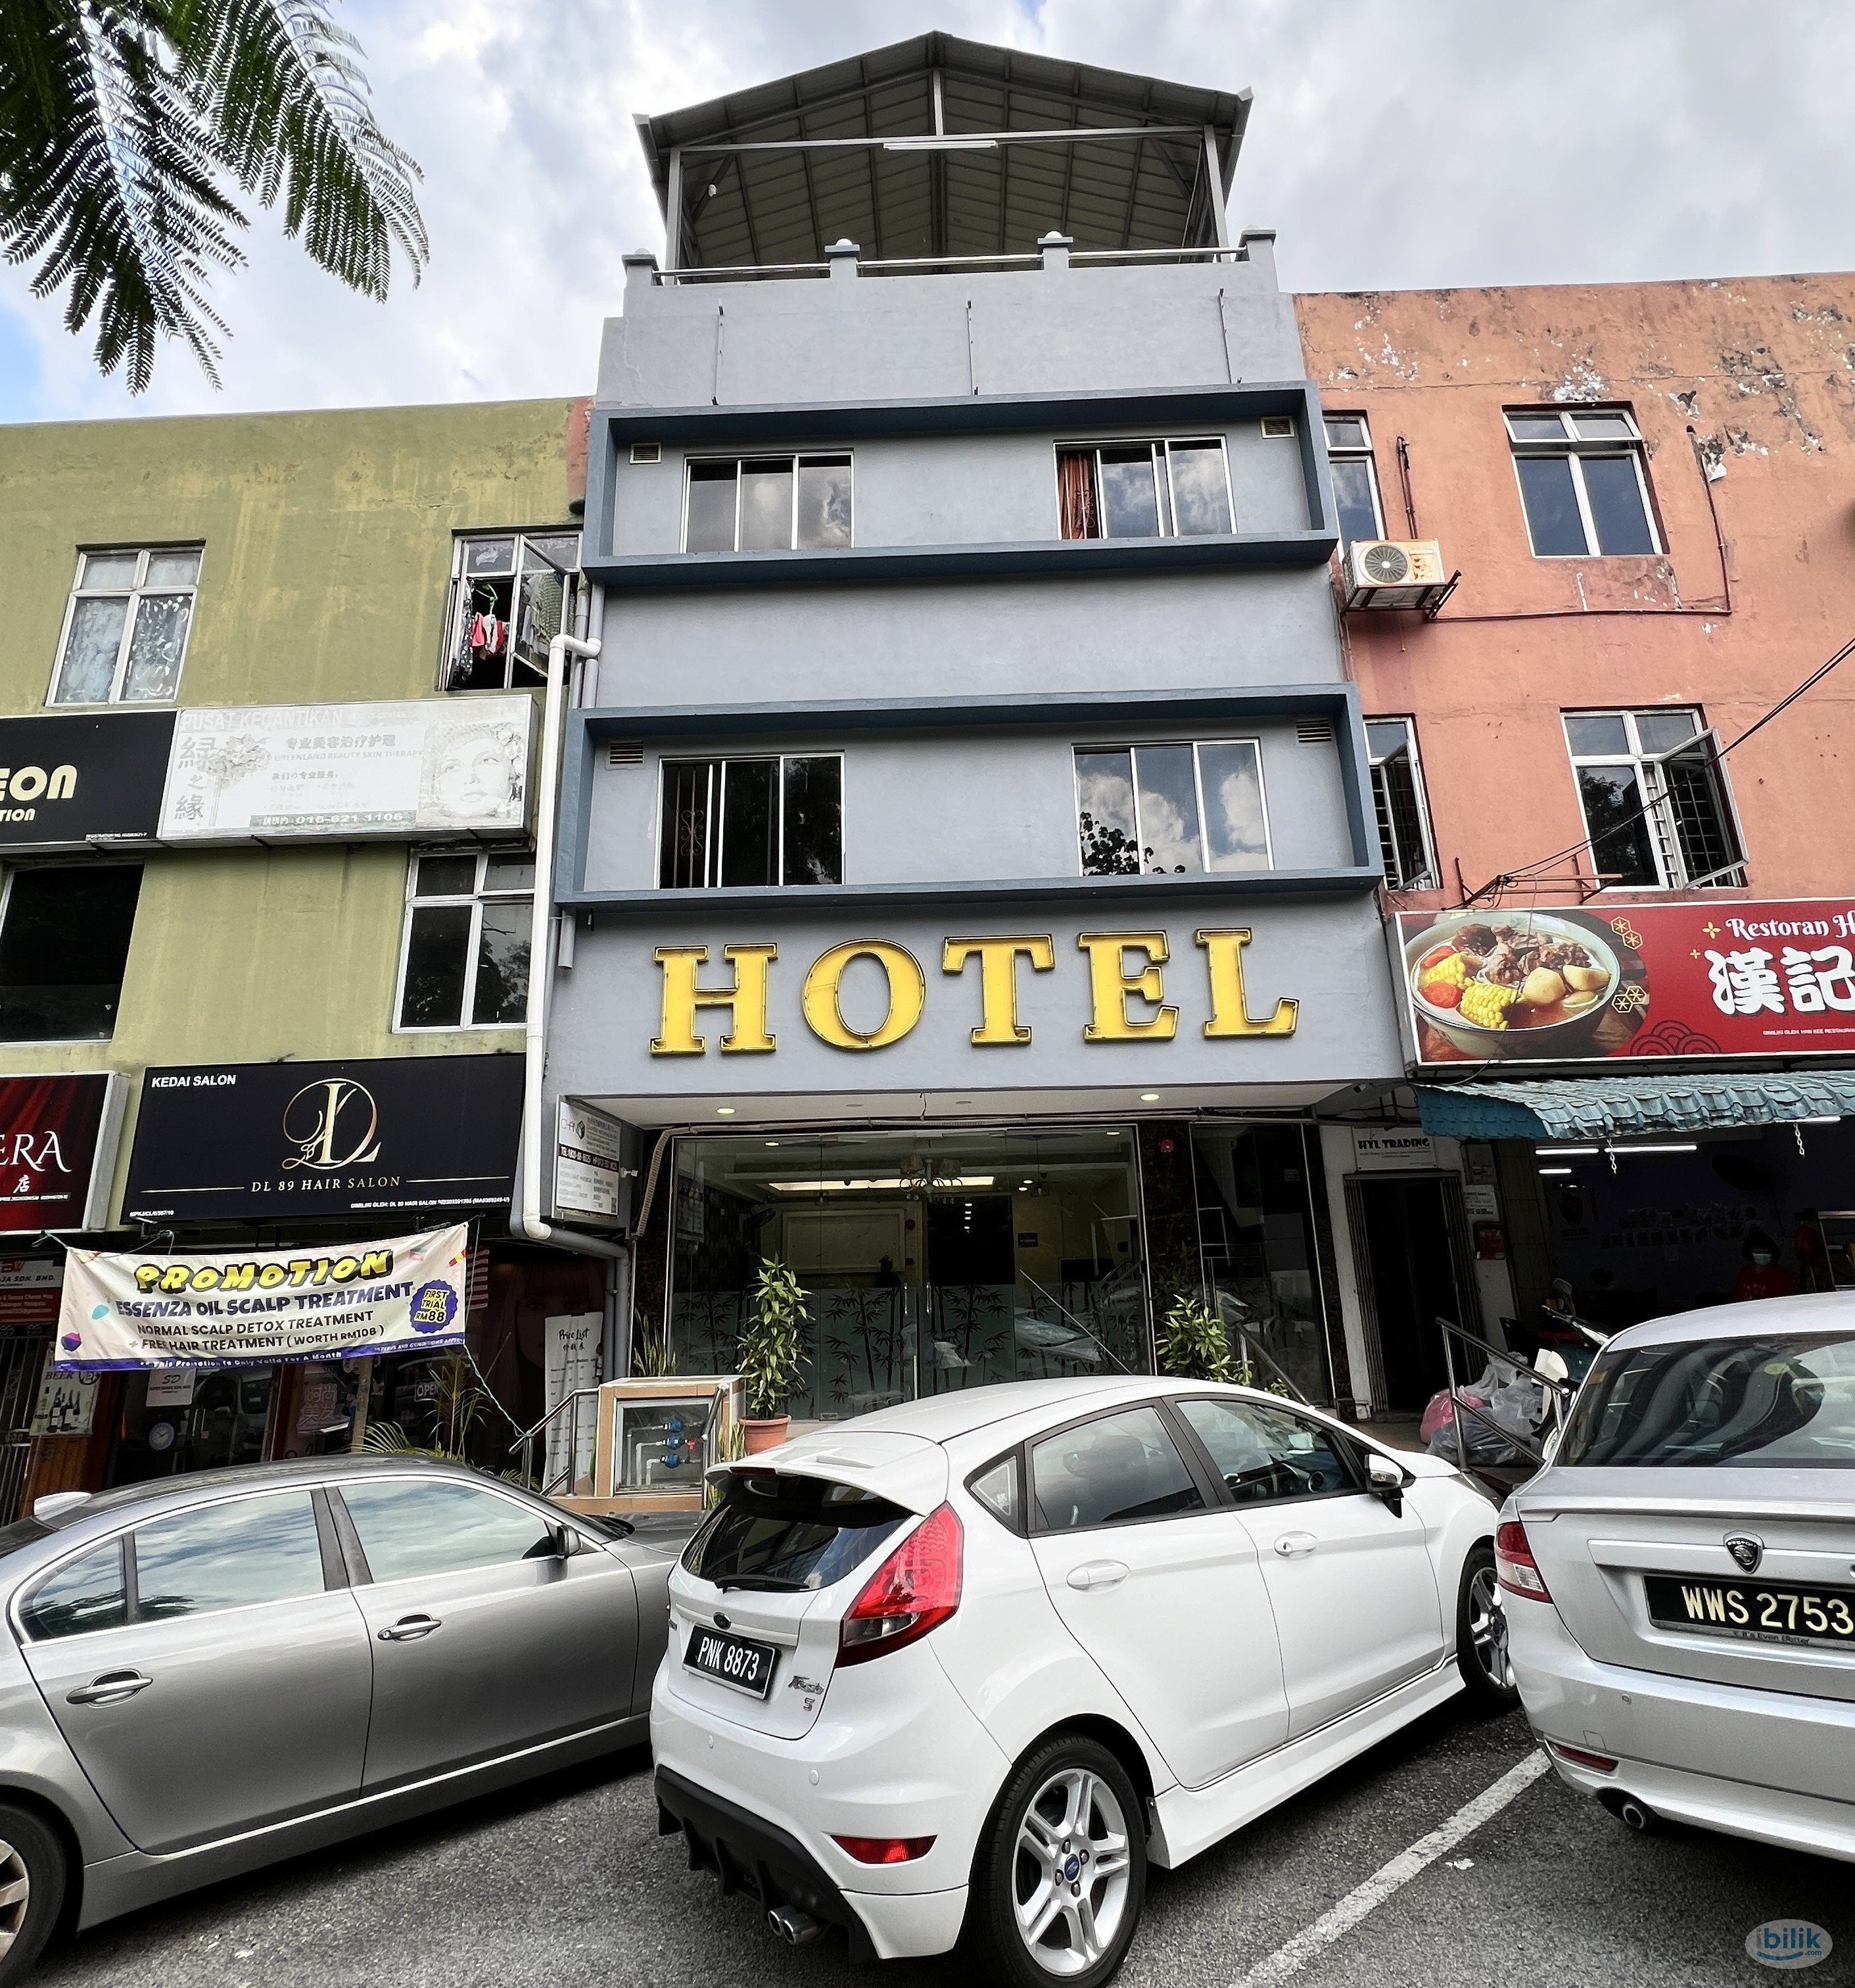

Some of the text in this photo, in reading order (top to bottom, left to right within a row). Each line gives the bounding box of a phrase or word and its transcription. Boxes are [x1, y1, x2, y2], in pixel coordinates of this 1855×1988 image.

[274, 753, 326, 762] GREENLAND
[327, 751, 361, 760] BEAUTY
[385, 749, 423, 758] THERAPY
[296, 814, 357, 824] 016-621
[364, 813, 404, 822] 1106
[1725, 918, 1829, 941] Restoran
[649, 928, 1300, 1055] HOTEL
[151, 1074, 237, 1088] KEDAI SALON
[1358, 1137, 1430, 1149] HYL TRADING
[250, 1175, 401, 1193] DL 89 HAIR SALON
[133, 1250, 394, 1294] PROMOTION
[115, 1281, 414, 1317] ESSENZA OIL SCALP TREATMENT
[424, 1290, 448, 1299] FIRST
[421, 1299, 446, 1309] TRIAL
[137, 1310, 374, 1336] NORMAL SCALP DETOX TREATMENT
[415, 1310, 445, 1322] RM88
[142, 1338, 167, 1349] FREE
[168, 1340, 199, 1351] HAIR
[202, 1337, 284, 1351] TREATMENT
[294, 1333, 338, 1346] WORTH
[340, 1326, 377, 1340] RM108
[559, 1327, 591, 1340] Price List
[312, 1351, 342, 1360] Month
[1681, 1586, 1854, 1634] WWS 2753
[697, 1636, 760, 1681] PNK 8873
